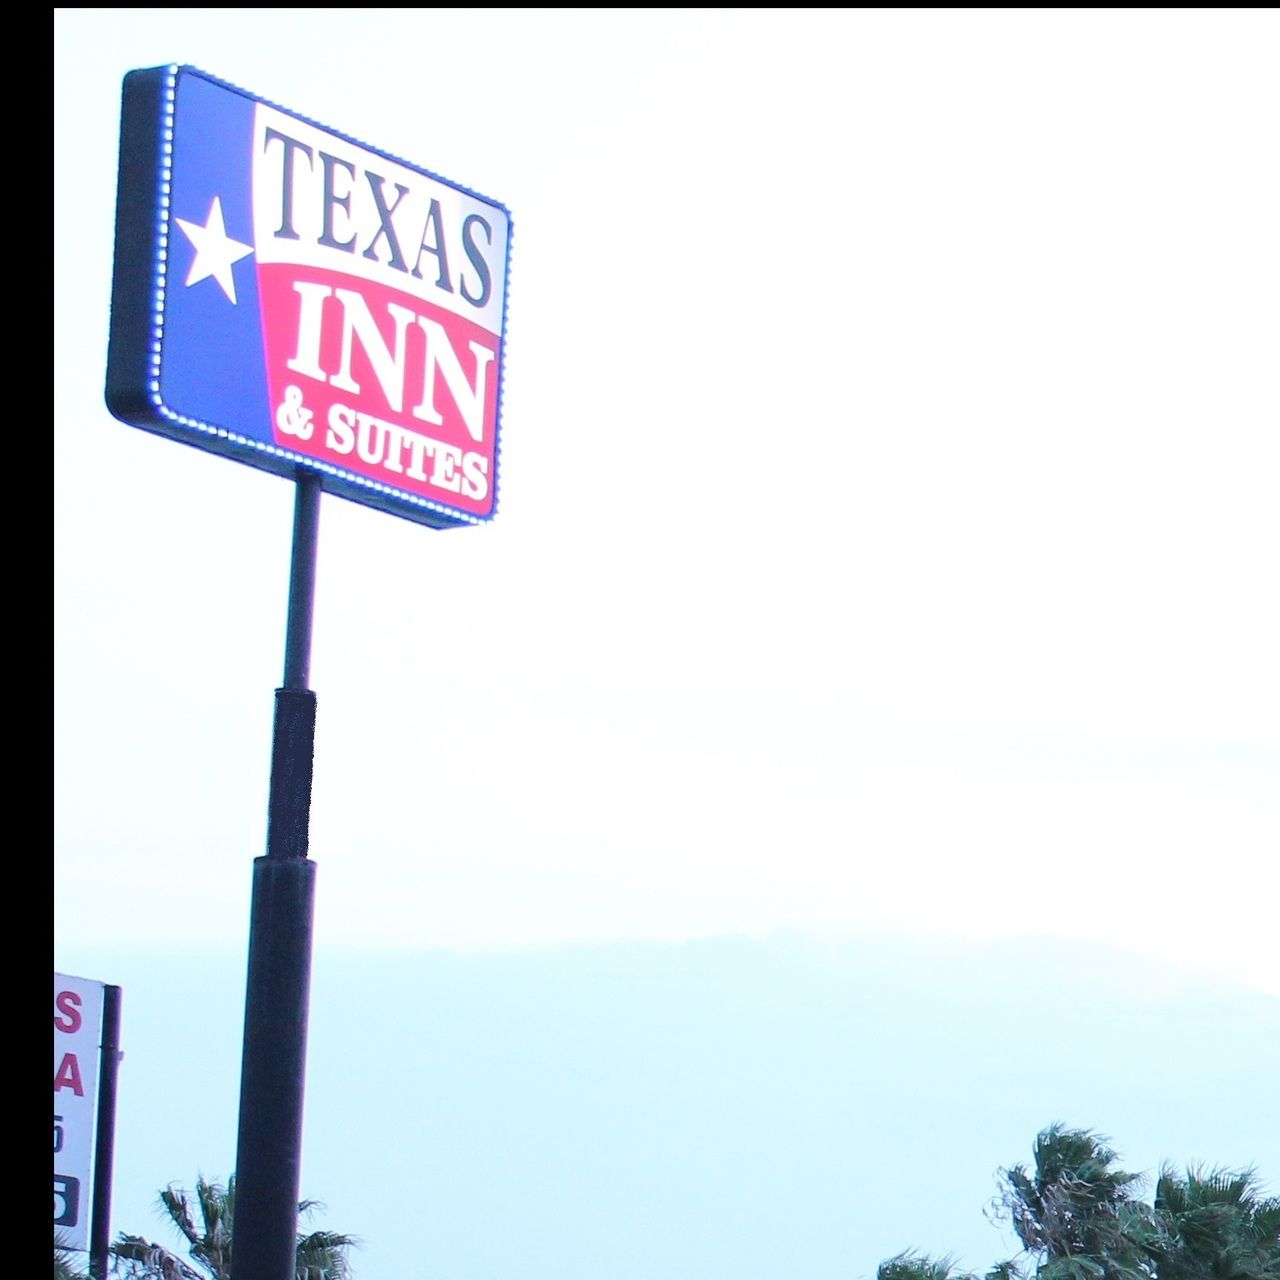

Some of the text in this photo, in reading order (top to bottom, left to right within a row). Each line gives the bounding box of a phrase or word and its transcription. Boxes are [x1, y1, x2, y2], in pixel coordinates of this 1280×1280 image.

[263, 125, 493, 309] TEXAS
[287, 281, 495, 443] INN
[276, 385, 489, 502] & SUITES
[54, 1052, 85, 1098] A
